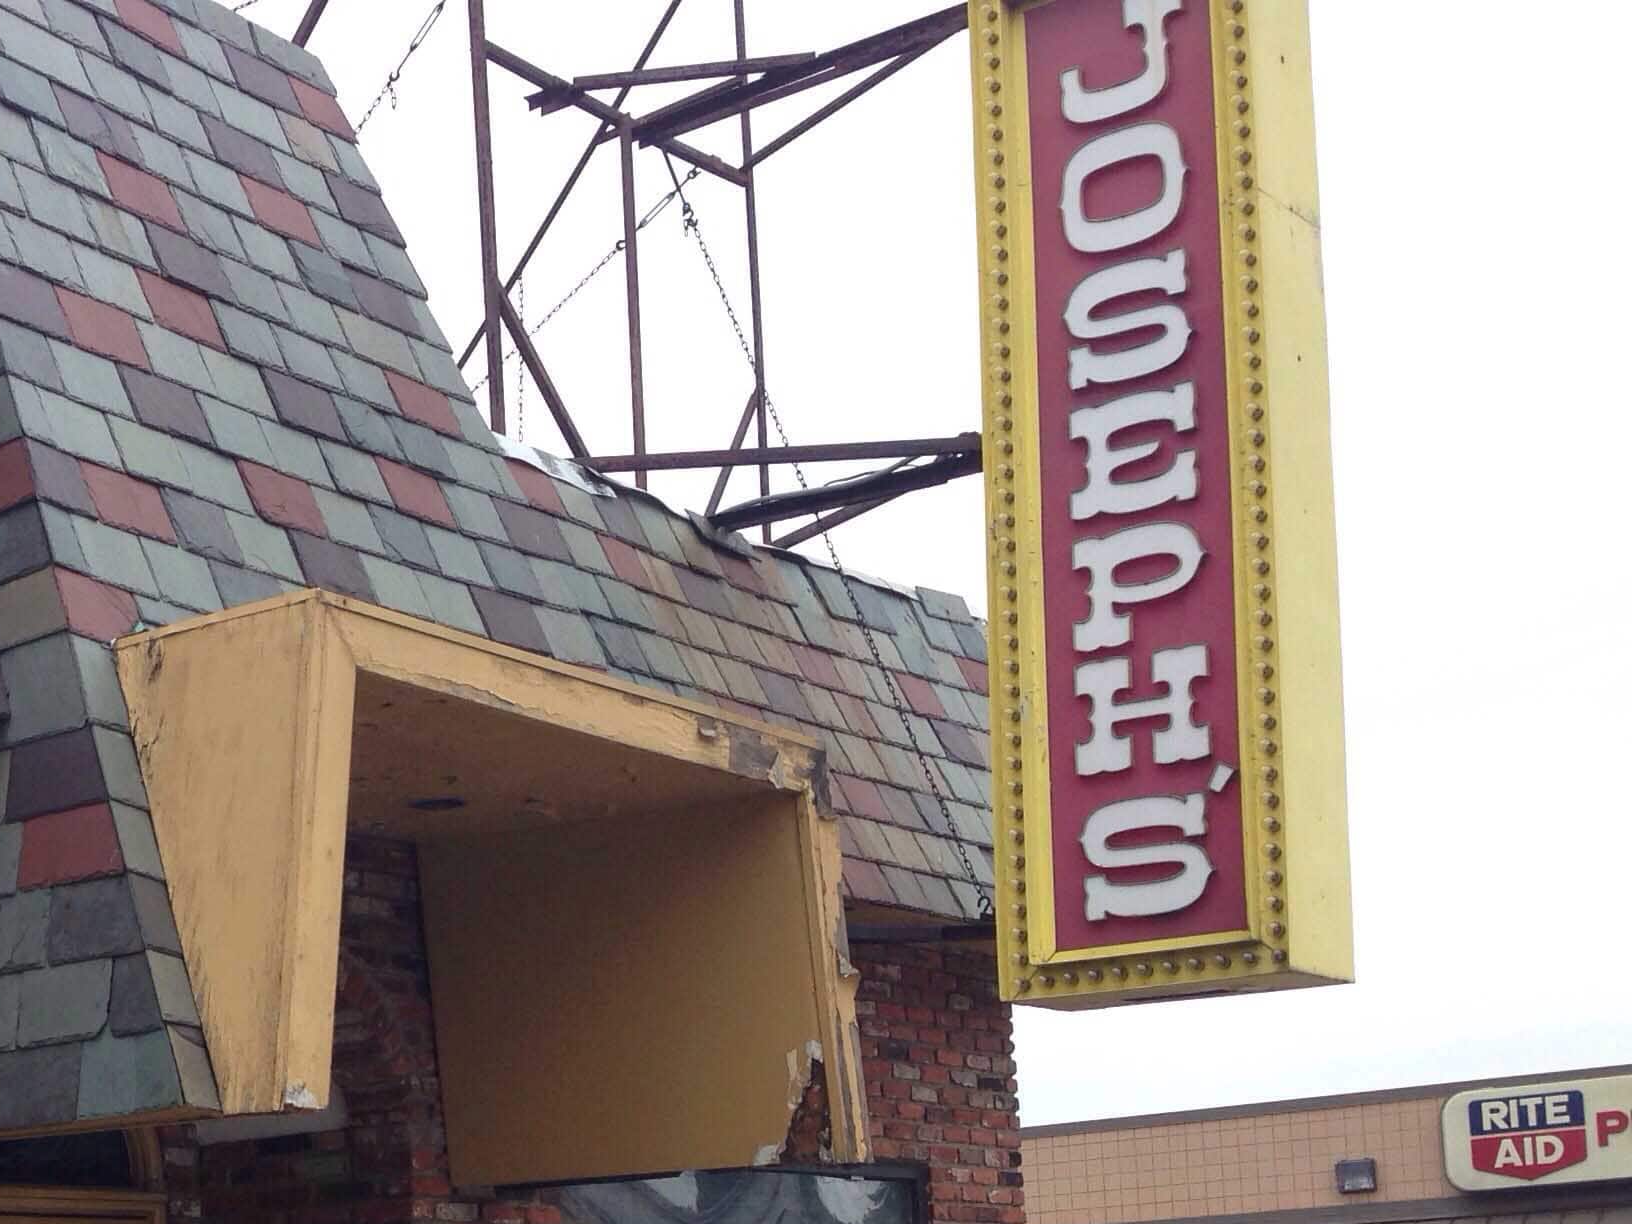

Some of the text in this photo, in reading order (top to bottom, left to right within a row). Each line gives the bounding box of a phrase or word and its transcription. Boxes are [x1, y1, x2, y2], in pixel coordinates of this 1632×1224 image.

[1057, 0, 1236, 923] JOSEPH'S
[1480, 1093, 1571, 1132] RITE
[1595, 1107, 1632, 1148] P
[1494, 1134, 1565, 1169] AID
